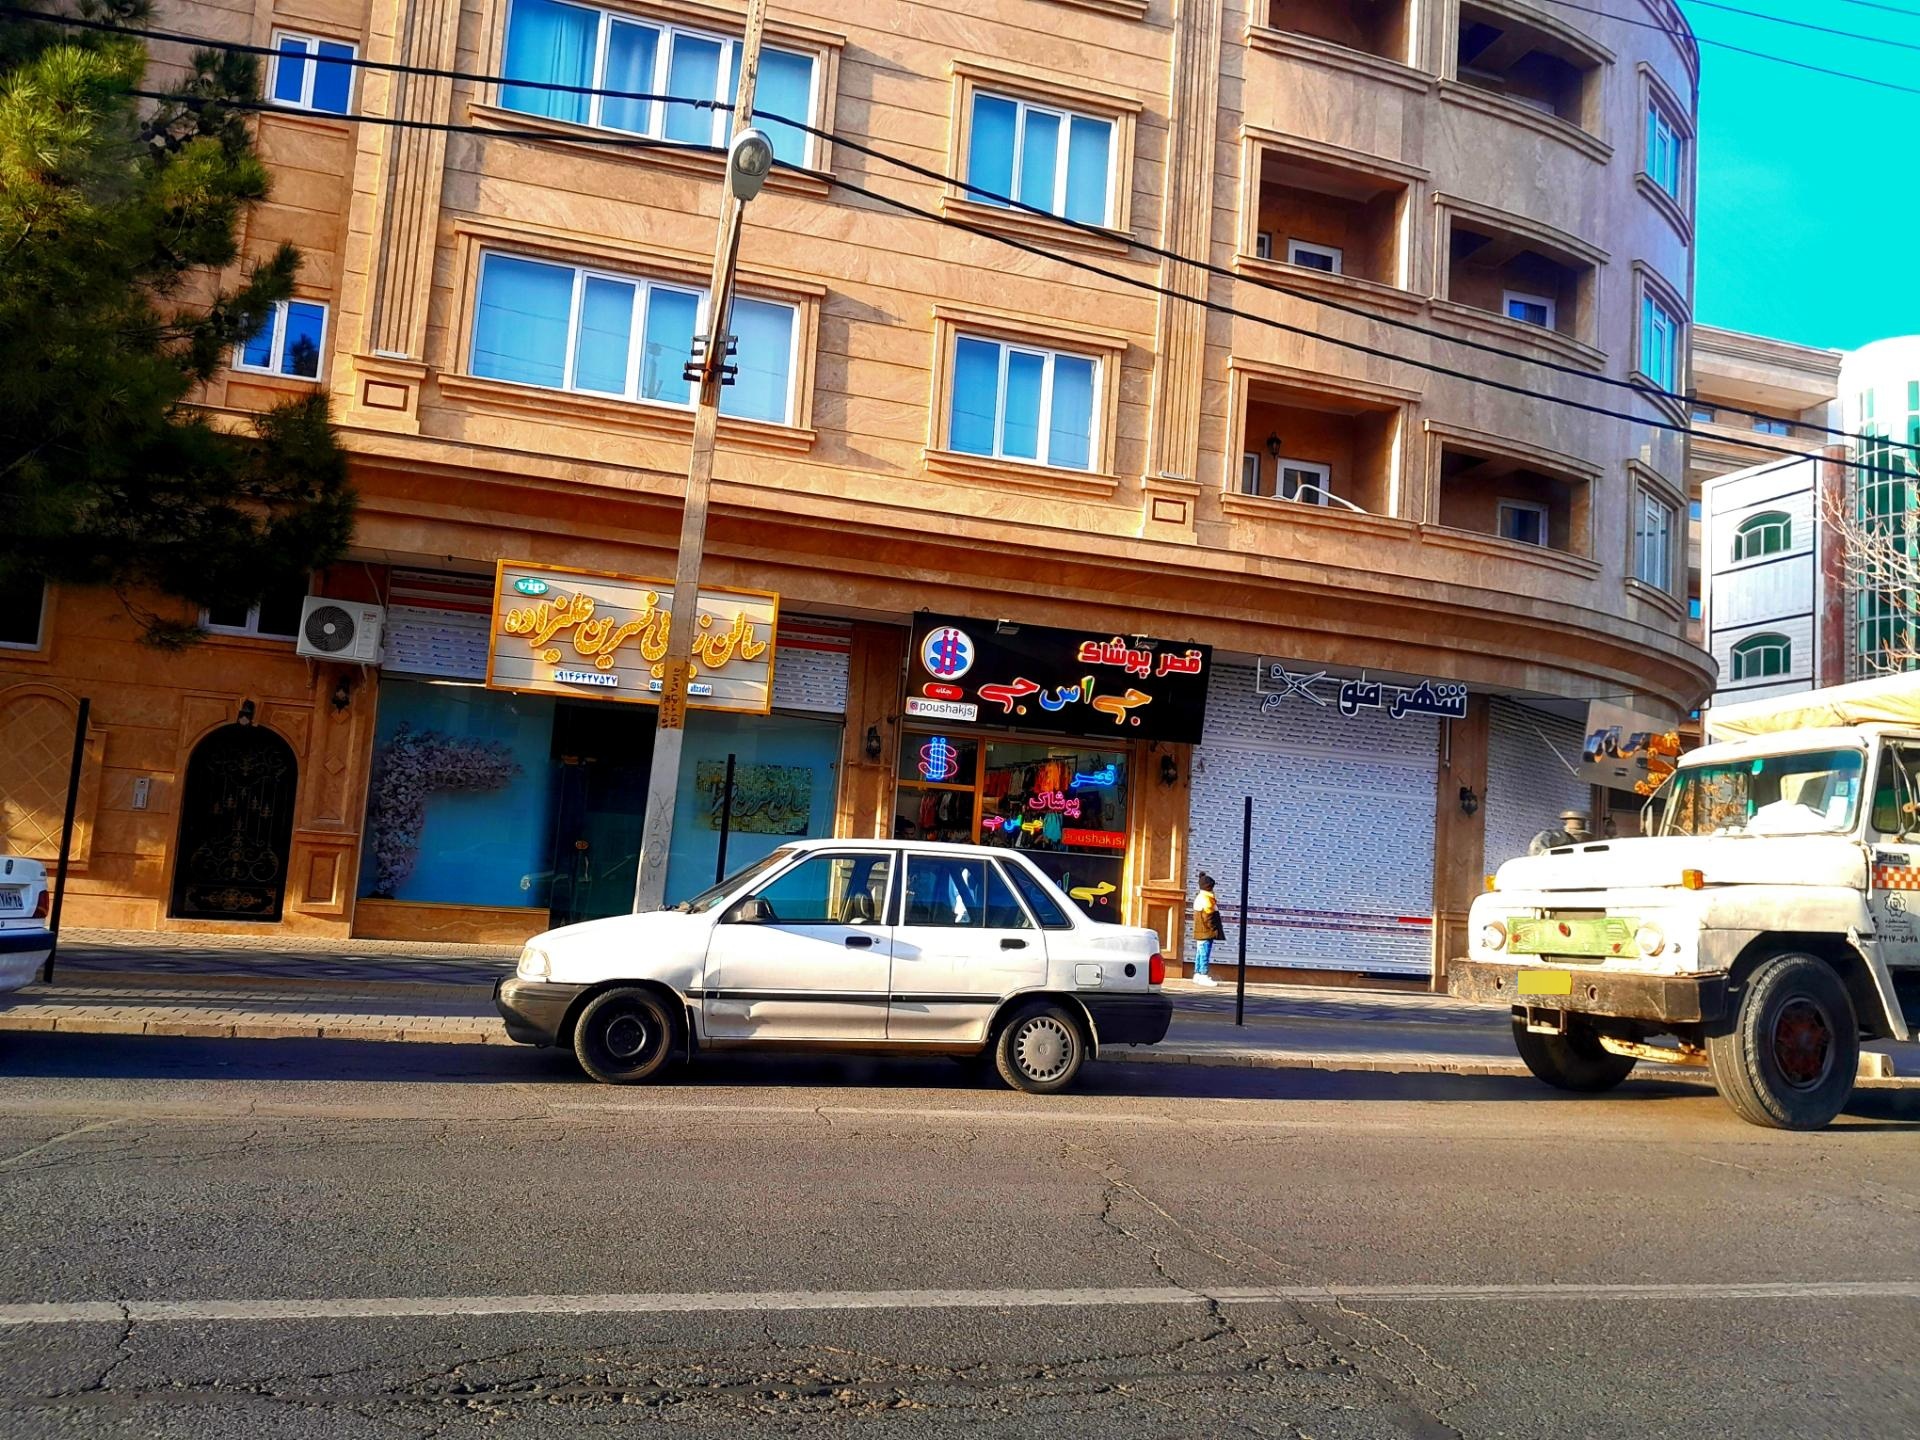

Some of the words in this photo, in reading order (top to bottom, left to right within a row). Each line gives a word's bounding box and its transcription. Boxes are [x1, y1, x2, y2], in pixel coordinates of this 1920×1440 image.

[517, 579, 546, 594] vip
[702, 611, 766, 668] سالن
[1078, 637, 1152, 679] پوشاک
[1156, 649, 1202, 678] قصر
[919, 702, 976, 717] poushakjsj
[1340, 680, 1382, 717] مو
[1390, 680, 1467, 719] شهر
[1070, 764, 1116, 788] قصر
[1029, 791, 1081, 819] پوشاک
